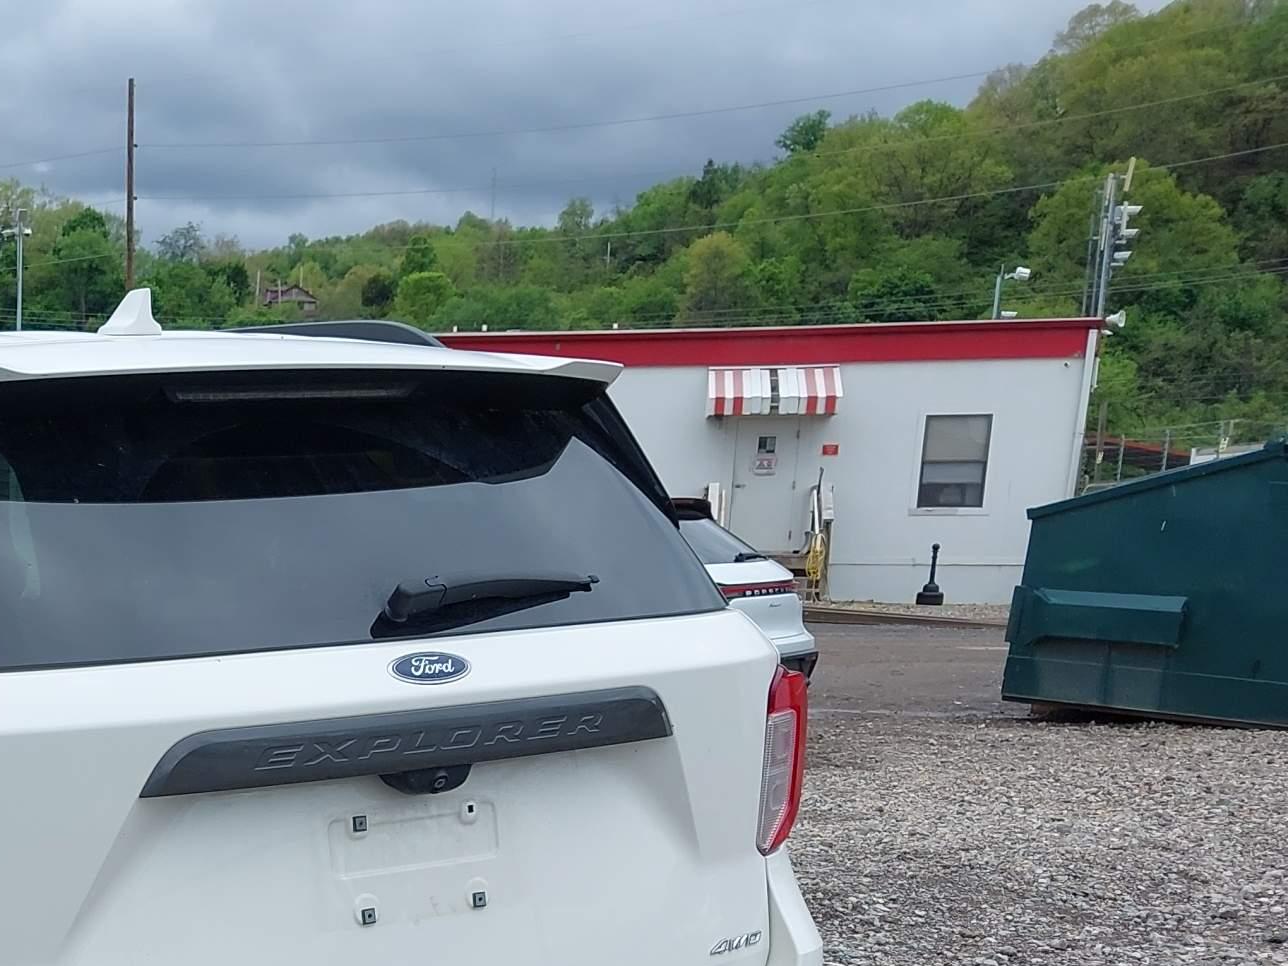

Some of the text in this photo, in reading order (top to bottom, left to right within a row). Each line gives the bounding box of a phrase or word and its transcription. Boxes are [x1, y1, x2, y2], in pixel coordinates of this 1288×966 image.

[411, 656, 455, 676] Ford
[254, 711, 605, 771] EXPLORER
[710, 930, 762, 955] 4WD
